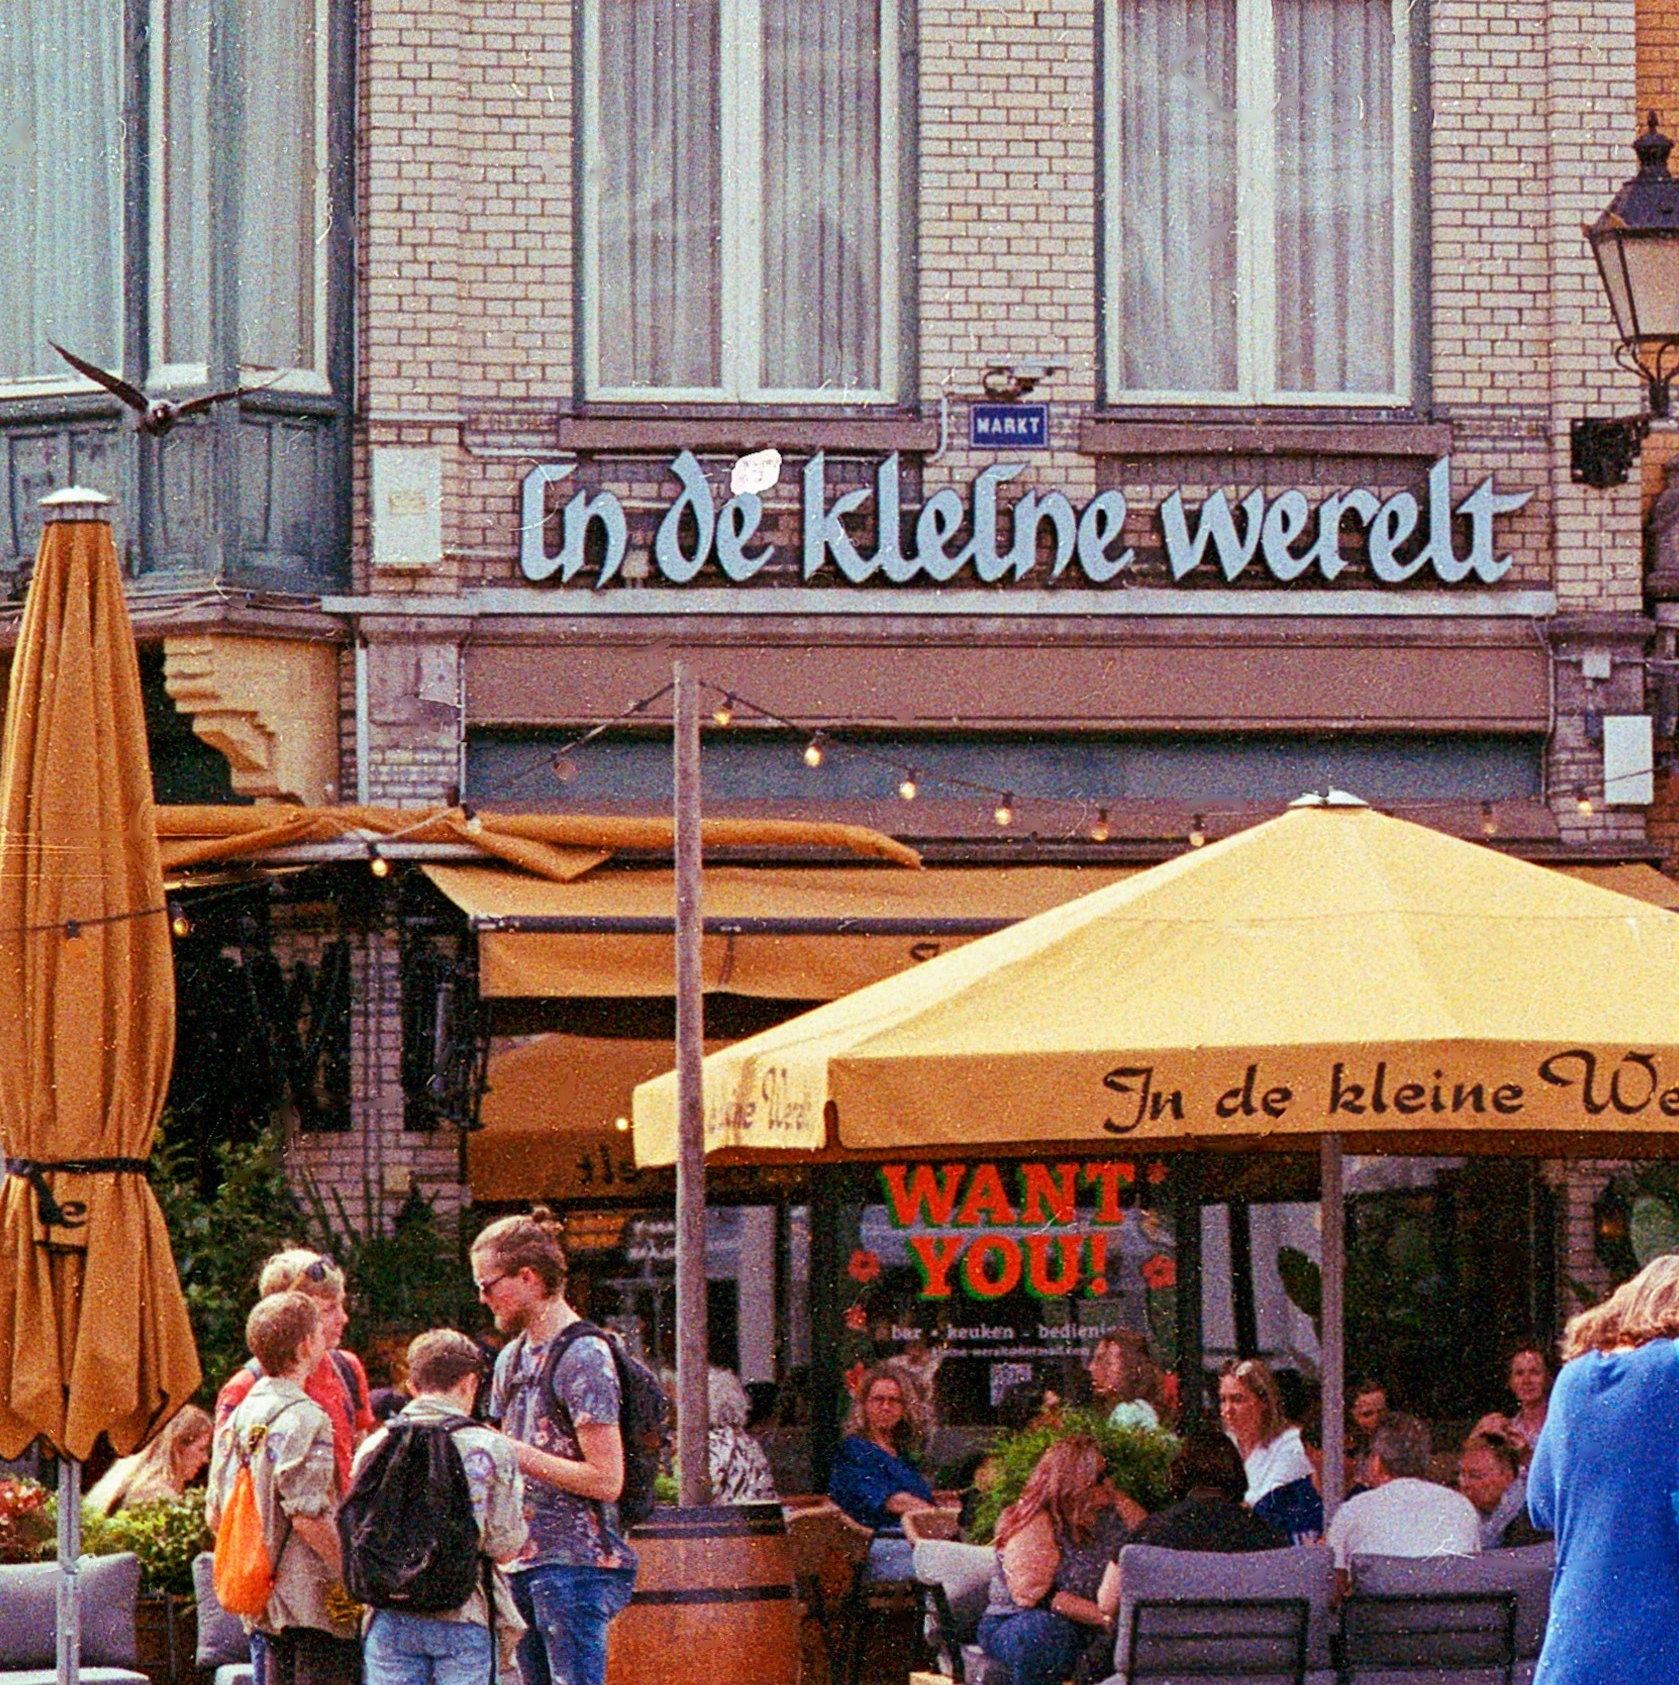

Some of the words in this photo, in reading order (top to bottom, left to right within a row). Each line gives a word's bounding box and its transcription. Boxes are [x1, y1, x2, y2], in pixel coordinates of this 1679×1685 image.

[976, 417, 1040, 434] MARKT
[656, 450, 775, 584] de
[804, 450, 1136, 584] kleine
[1161, 454, 1535, 584] werelt
[1102, 1066, 1185, 1134] In
[1215, 1064, 1293, 1119] de
[1329, 1061, 1525, 1115] kleine
[877, 1161, 1137, 1227] WANT
[906, 1233, 1109, 1301] YOU!
[891, 1324, 922, 1340] bar
[947, 1323, 1015, 1340] keuken
